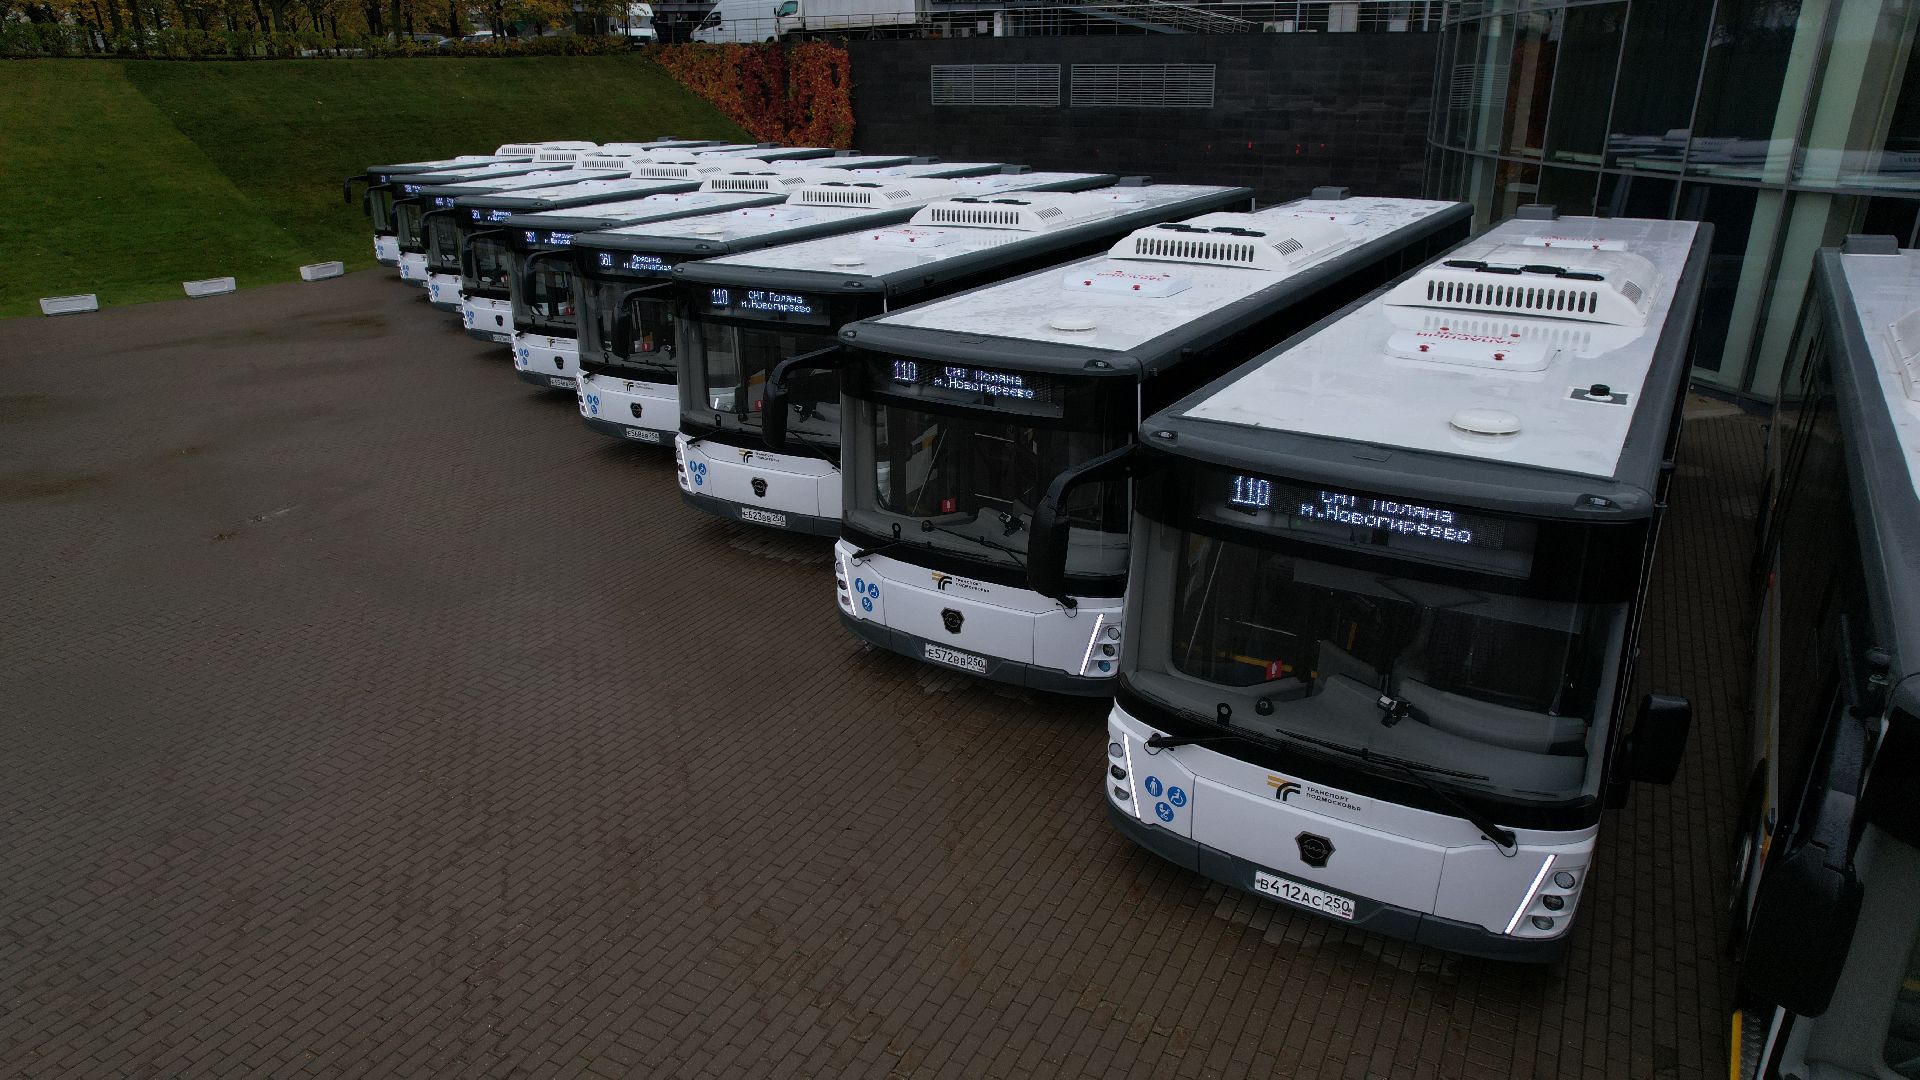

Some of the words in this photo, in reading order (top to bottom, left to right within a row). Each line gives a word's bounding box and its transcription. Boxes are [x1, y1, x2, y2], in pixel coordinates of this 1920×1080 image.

[711, 288, 728, 305] 110
[748, 290, 765, 300] СНТ
[769, 292, 803, 304] Поляна
[894, 360, 918, 382] 110
[1231, 475, 1272, 506] 110
[1306, 792, 1361, 812] ПОДМОСКОВЬЯ
[1307, 786, 1349, 802] ТРАНСПОРТ
[1260, 878, 1322, 907] В412АС
[1324, 895, 1350, 912] 250
